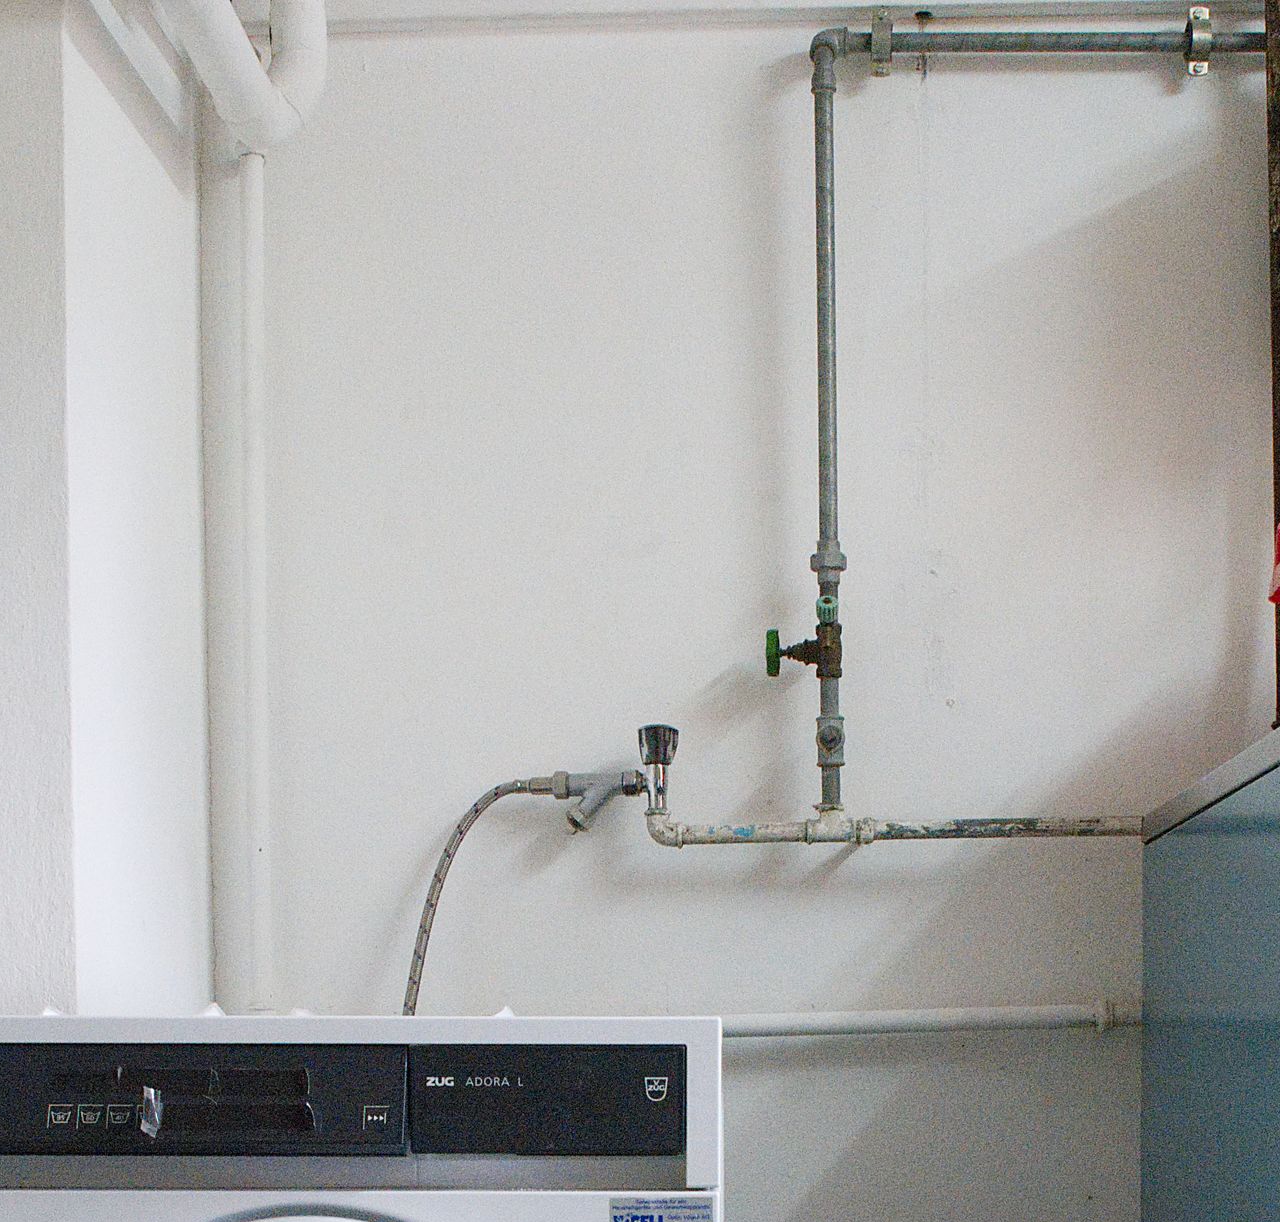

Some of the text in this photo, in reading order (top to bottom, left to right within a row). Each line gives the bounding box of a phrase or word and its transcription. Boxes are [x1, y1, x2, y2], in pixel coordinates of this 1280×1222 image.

[426, 1076, 524, 1087] ZUG ADORA L
